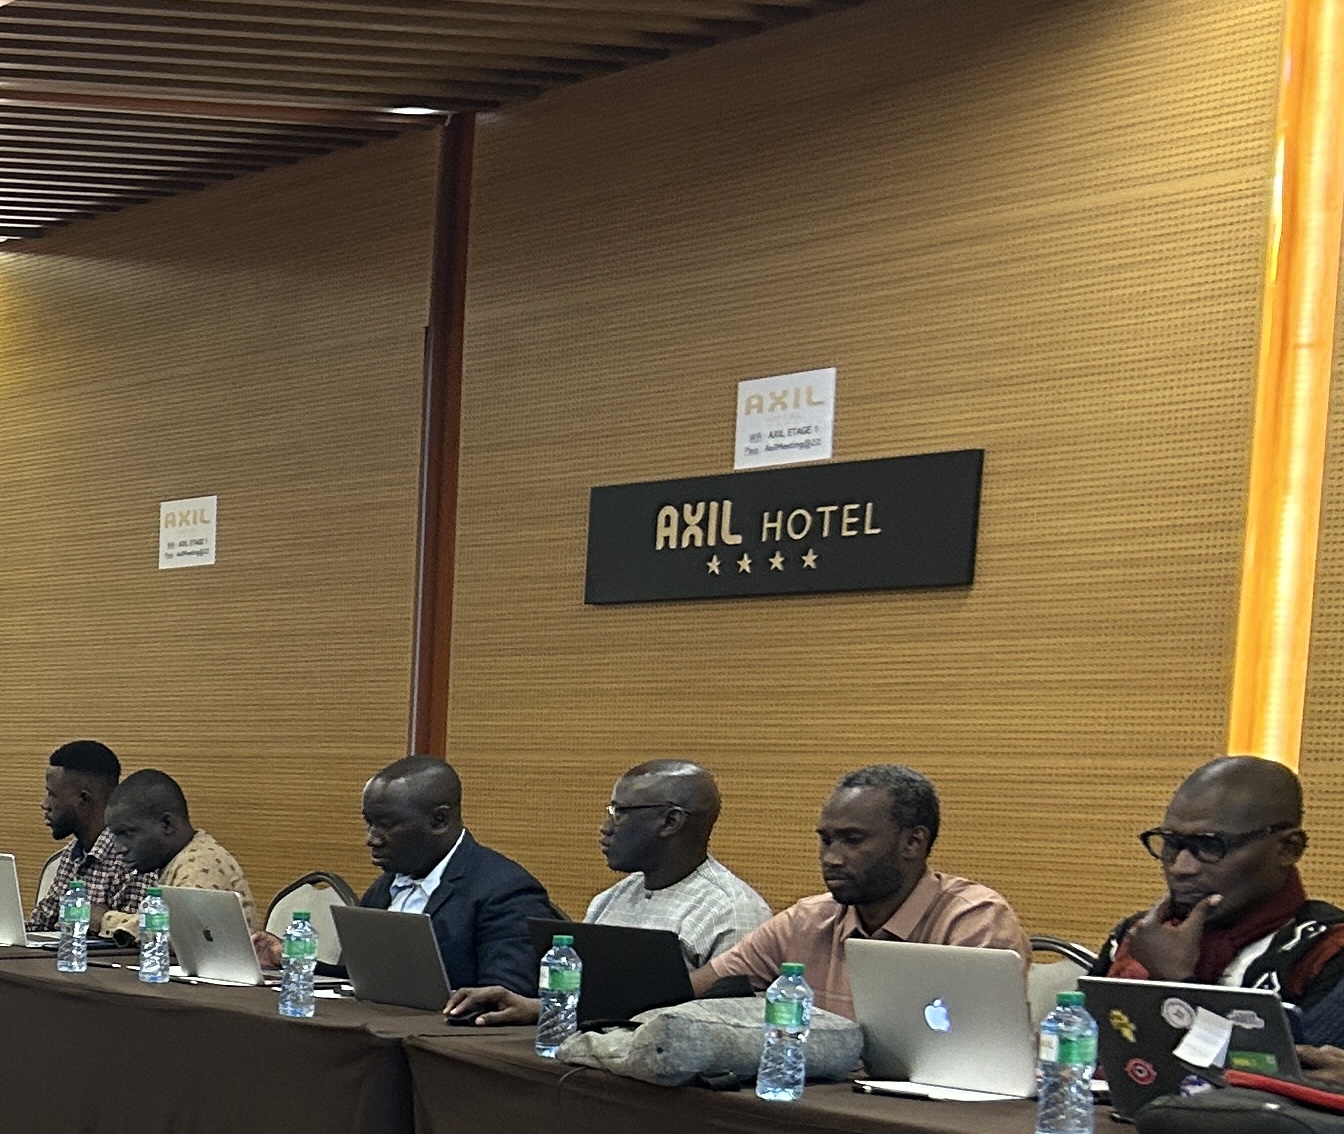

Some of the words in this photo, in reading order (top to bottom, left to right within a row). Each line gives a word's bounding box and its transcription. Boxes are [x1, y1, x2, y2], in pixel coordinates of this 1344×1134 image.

[745, 385, 824, 416] AXIL
[164, 508, 211, 529] AXIL
[655, 500, 743, 551] AXIL
[762, 502, 882, 543] HOTEL
